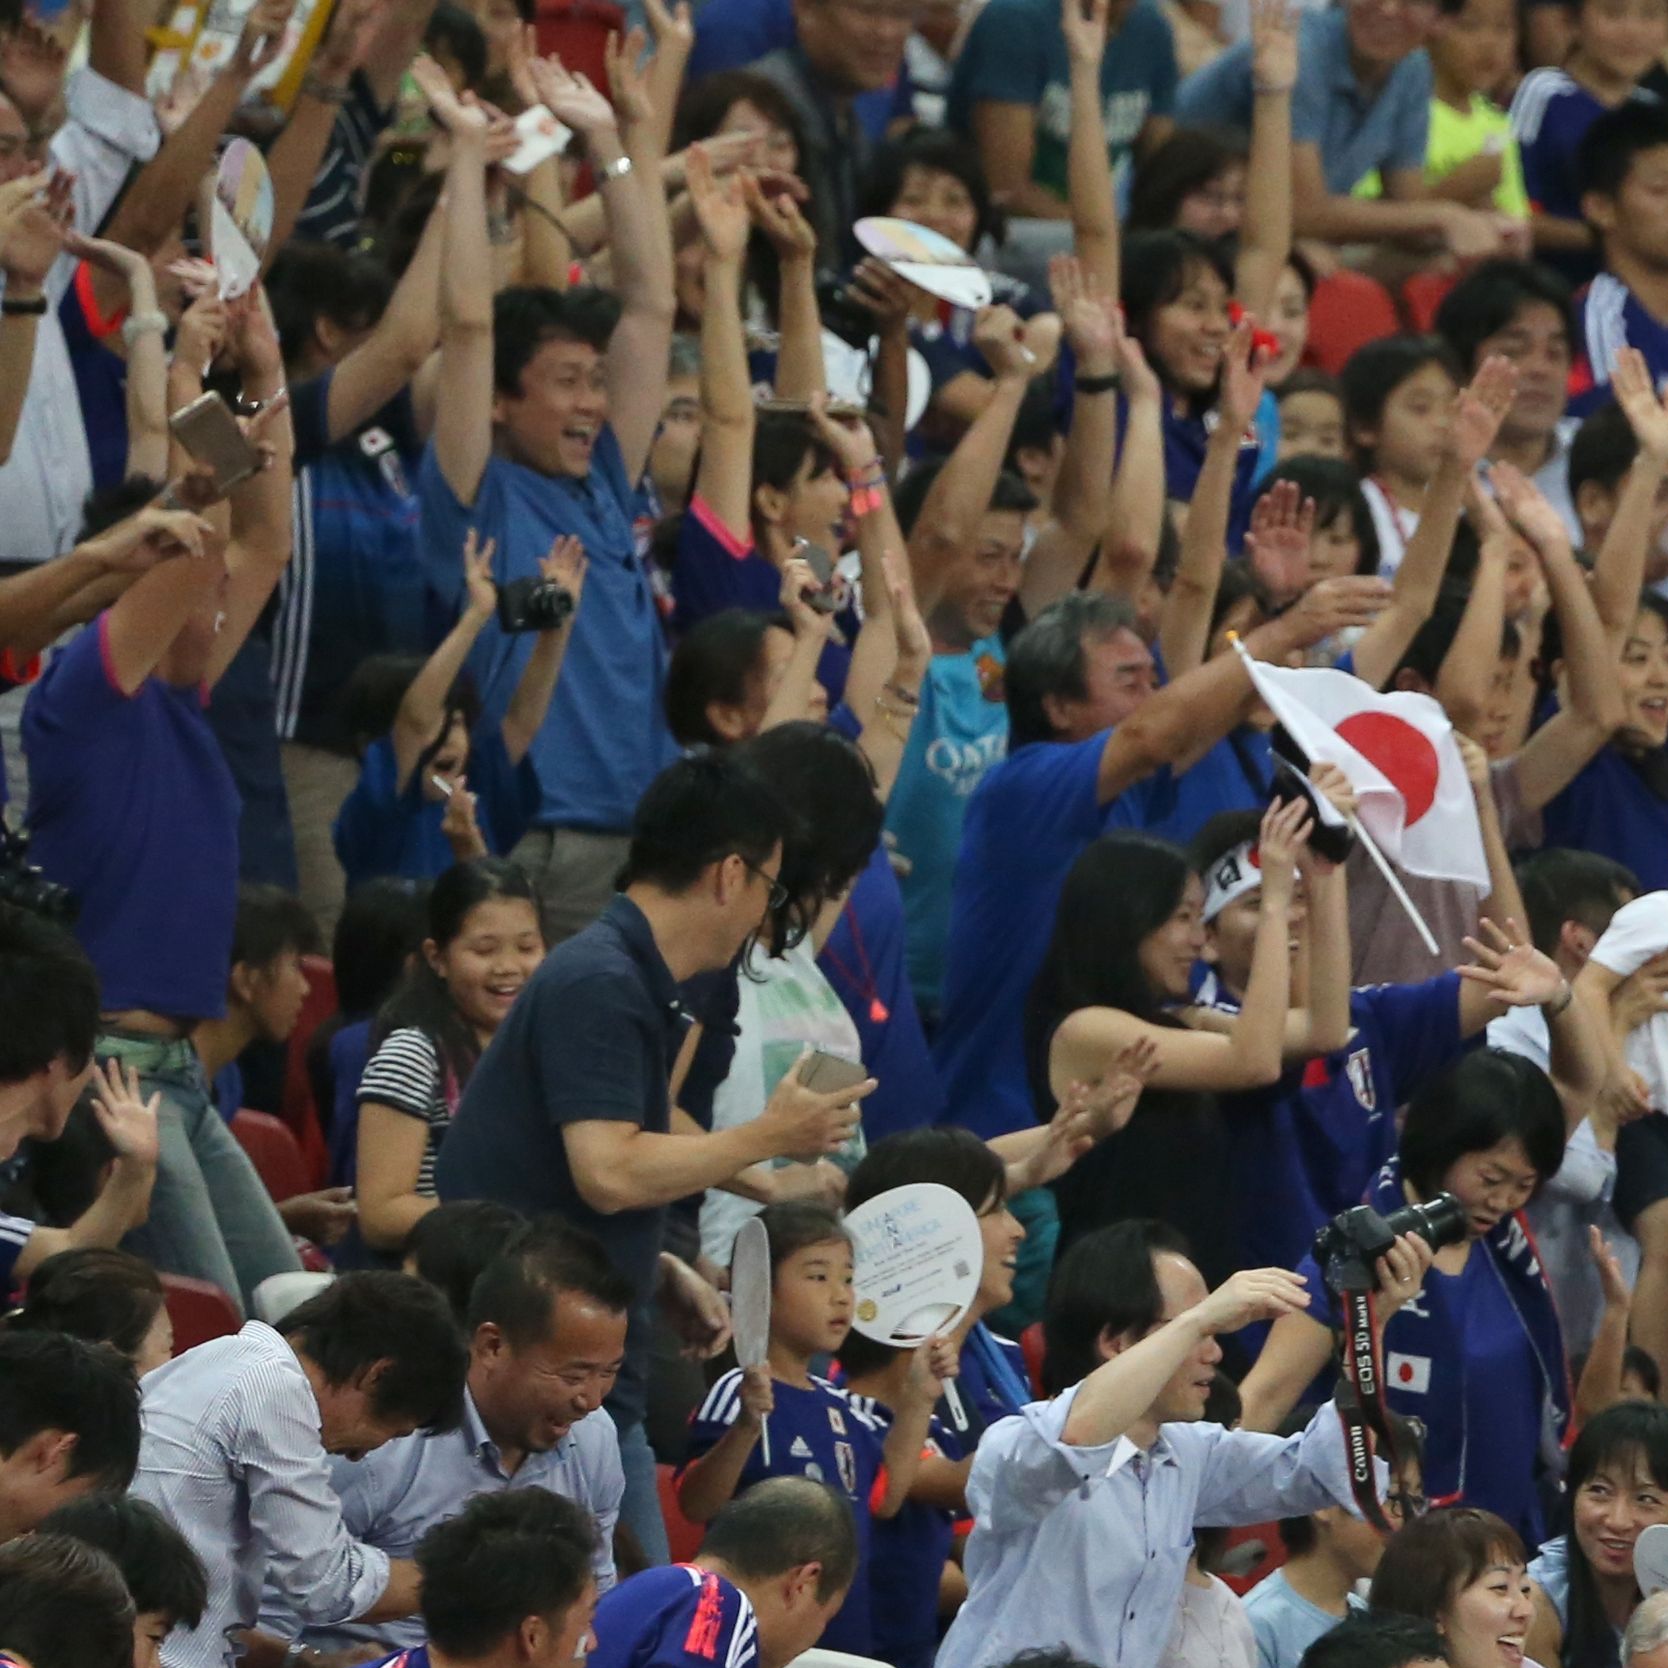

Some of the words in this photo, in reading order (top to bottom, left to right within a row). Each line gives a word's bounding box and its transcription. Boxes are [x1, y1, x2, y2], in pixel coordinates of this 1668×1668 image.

[1354, 1330, 1371, 1352] 5D
[1358, 1355, 1376, 1396] EOS
[1350, 1425, 1369, 1483] Canon
